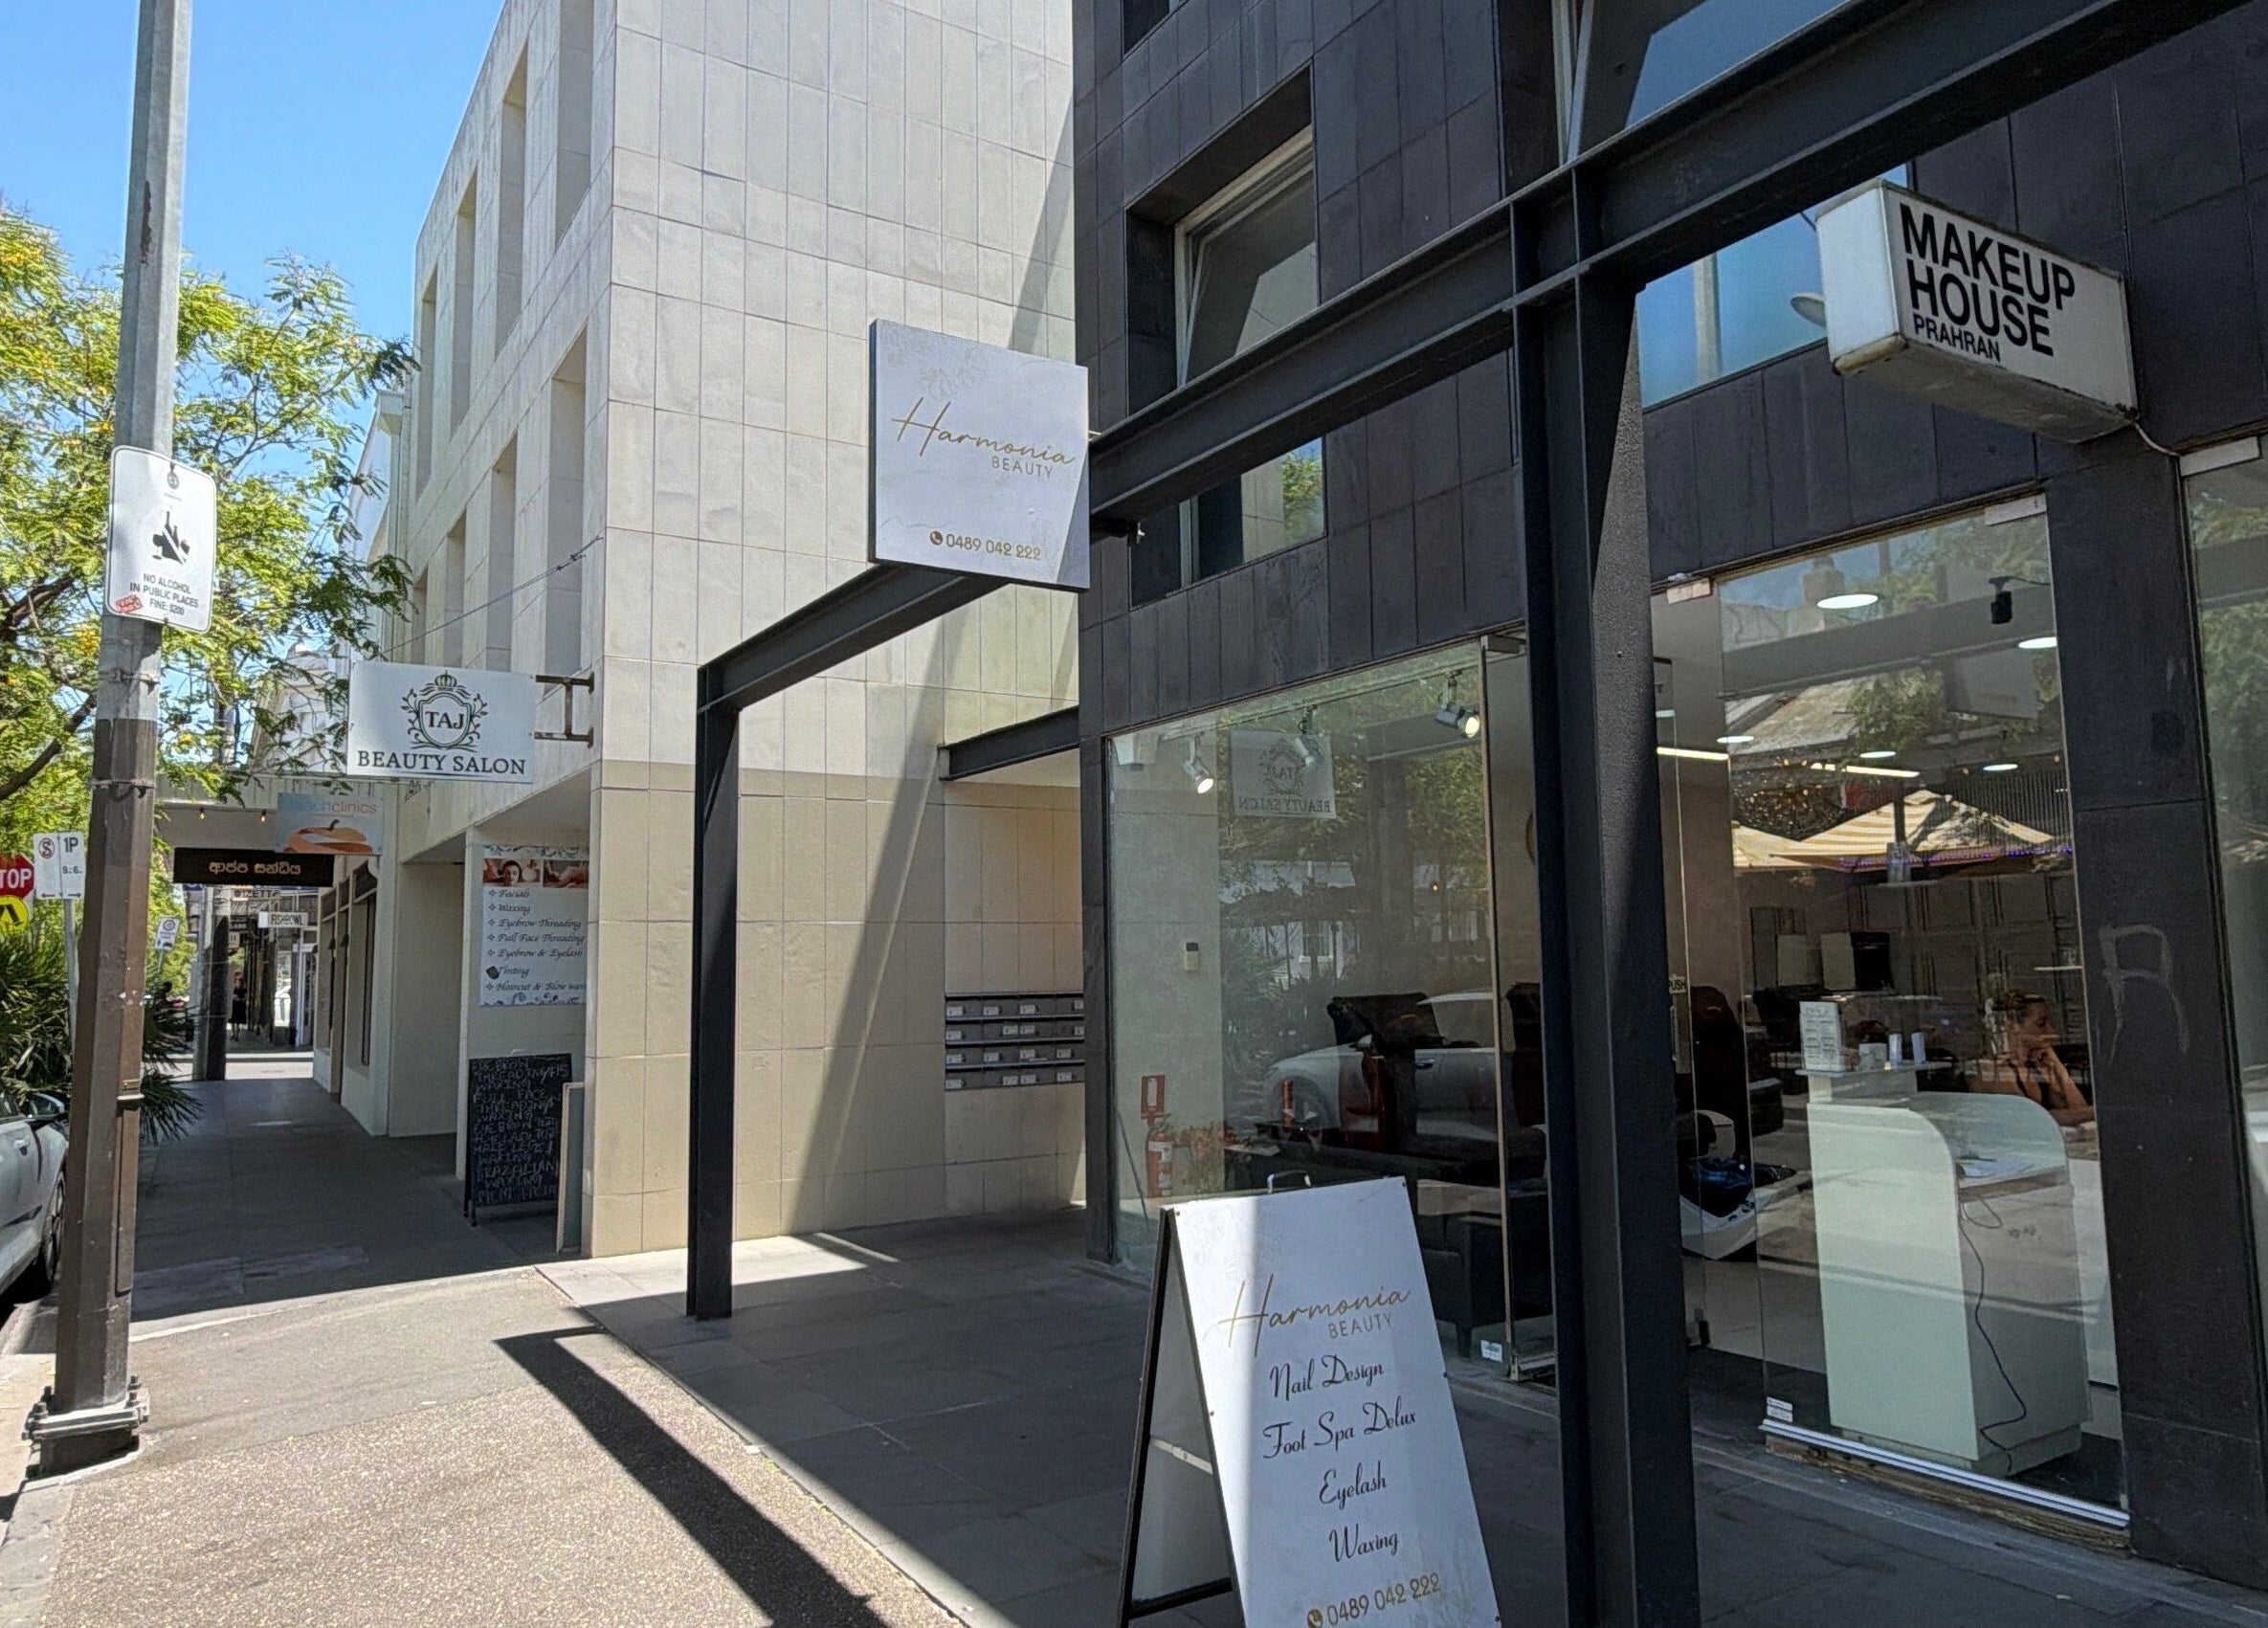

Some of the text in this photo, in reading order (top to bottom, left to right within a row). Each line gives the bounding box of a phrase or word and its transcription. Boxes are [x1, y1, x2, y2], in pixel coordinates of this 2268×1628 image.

[1900, 202, 2076, 311] MAKEUP
[1906, 257, 2055, 357] HOUSE
[1913, 313, 2001, 363] PRAHRAN
[891, 396, 1076, 464] Harmonia
[991, 456, 1054, 479] BEAUTY
[945, 532, 1041, 560] 0489 042 222
[129, 582, 199, 608] IN PUBLIC PLACES
[143, 573, 191, 594] NO ALCOHOL
[425, 710, 465, 729] TAJ
[358, 749, 525, 775] BEAUTY SALON
[63, 836, 78, 853] 1P
[0, 868, 32, 888] TOP
[499, 903, 531, 916] Waxing
[498, 917, 582, 931] Eyebrow Threading
[498, 932, 518, 943] Full
[542, 933, 585, 946] Threading
[498, 948, 535, 962] Eyebrow
[549, 948, 583, 961] Eyelash
[1217, 1273, 1412, 1357] Harmonia
[1328, 1312, 1393, 1339] BEAUTY
[1269, 1354, 1385, 1401] Nail Design
[1262, 1395, 1416, 1459] Foot Spa Delux
[1319, 1461, 1388, 1509] Eyelash
[1329, 1524, 1399, 1562] Waxing
[1326, 1572, 1440, 1626] 0489 042 222
